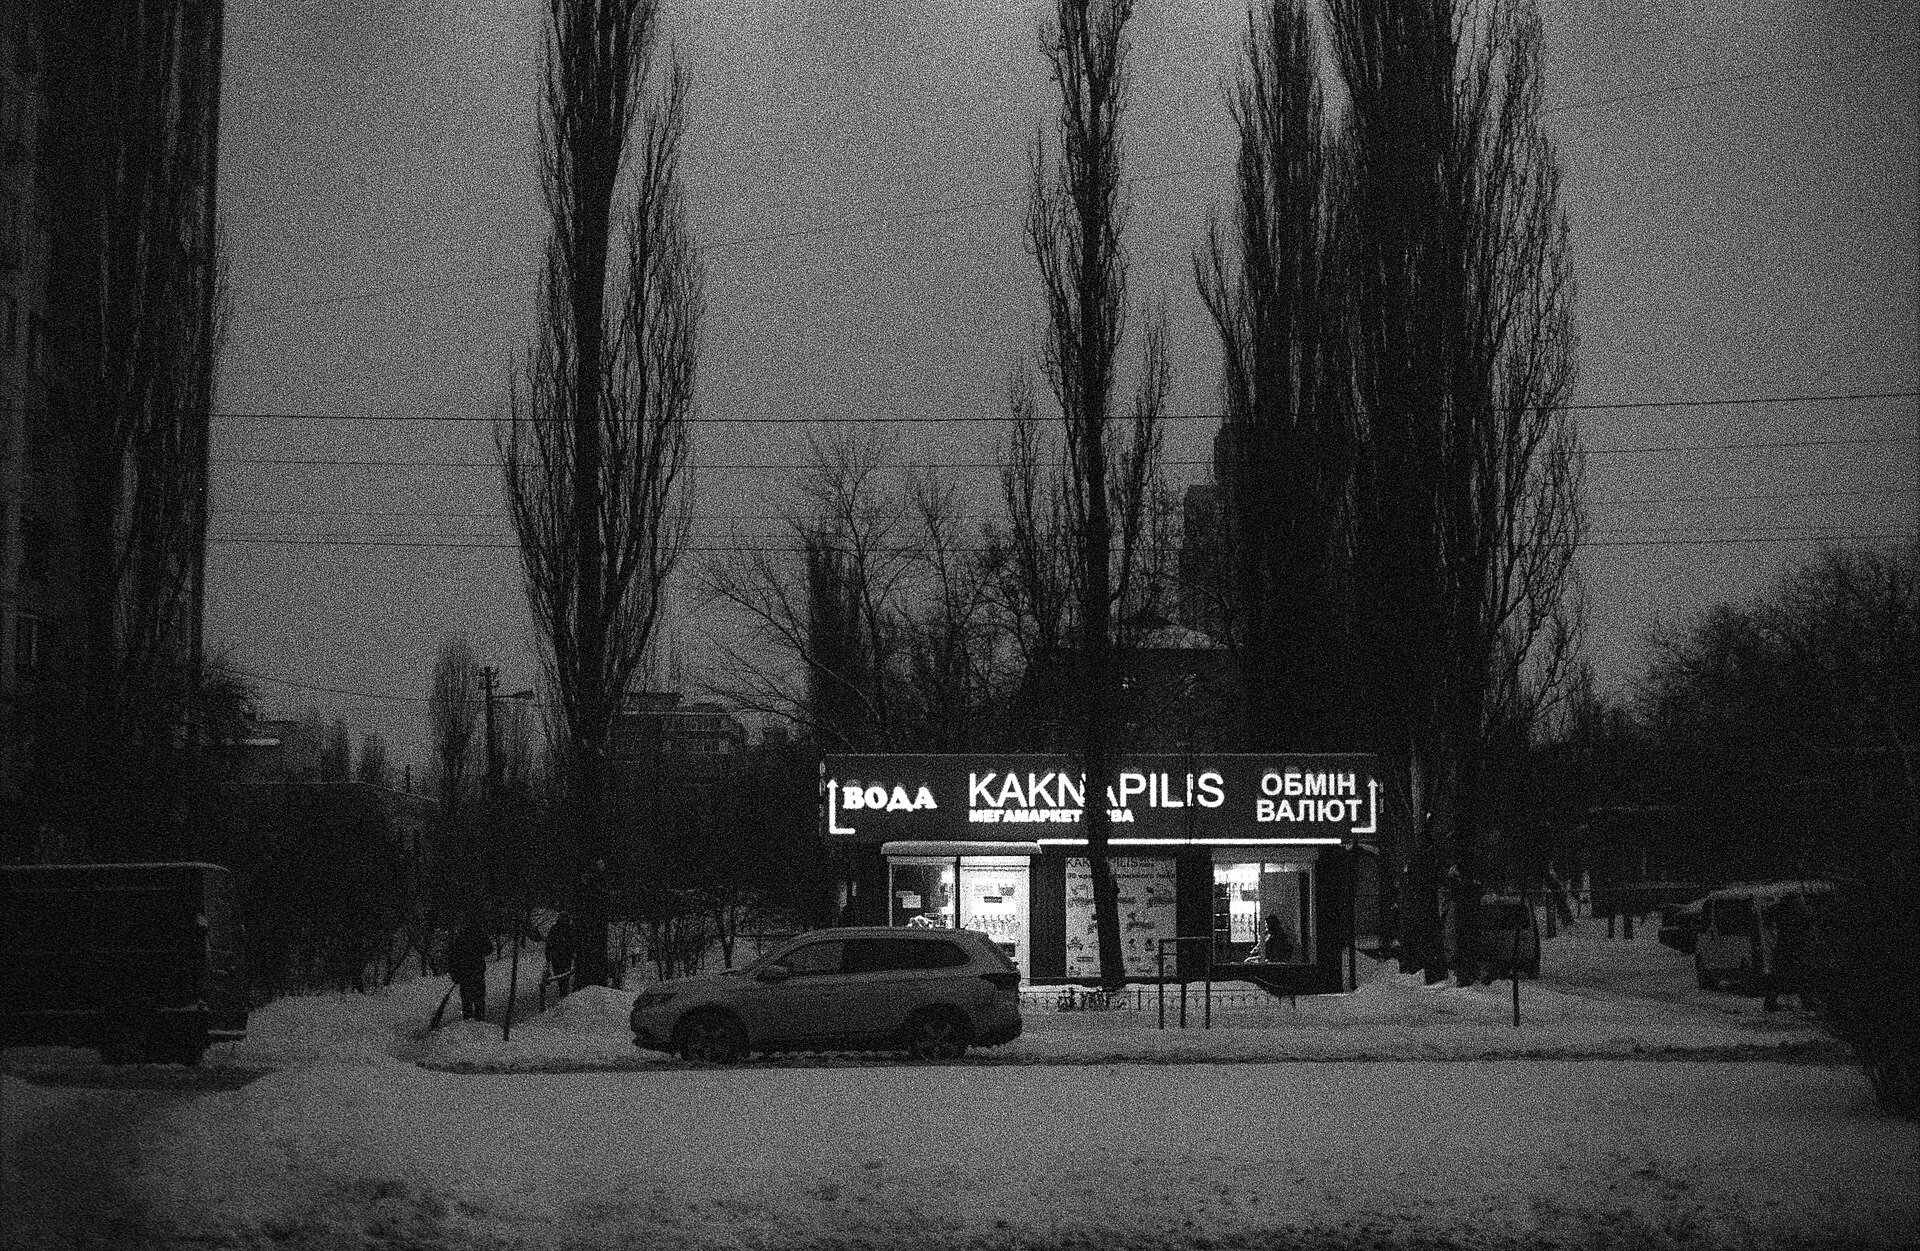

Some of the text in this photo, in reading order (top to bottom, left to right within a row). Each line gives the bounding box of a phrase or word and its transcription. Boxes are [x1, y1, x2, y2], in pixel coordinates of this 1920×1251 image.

[1261, 773, 1355, 796] ОБМІН
[842, 786, 938, 812] ВОДА
[1256, 799, 1362, 822] ВАЛЮТ
[968, 808, 1083, 823] МЕГАМАРКЕТ
